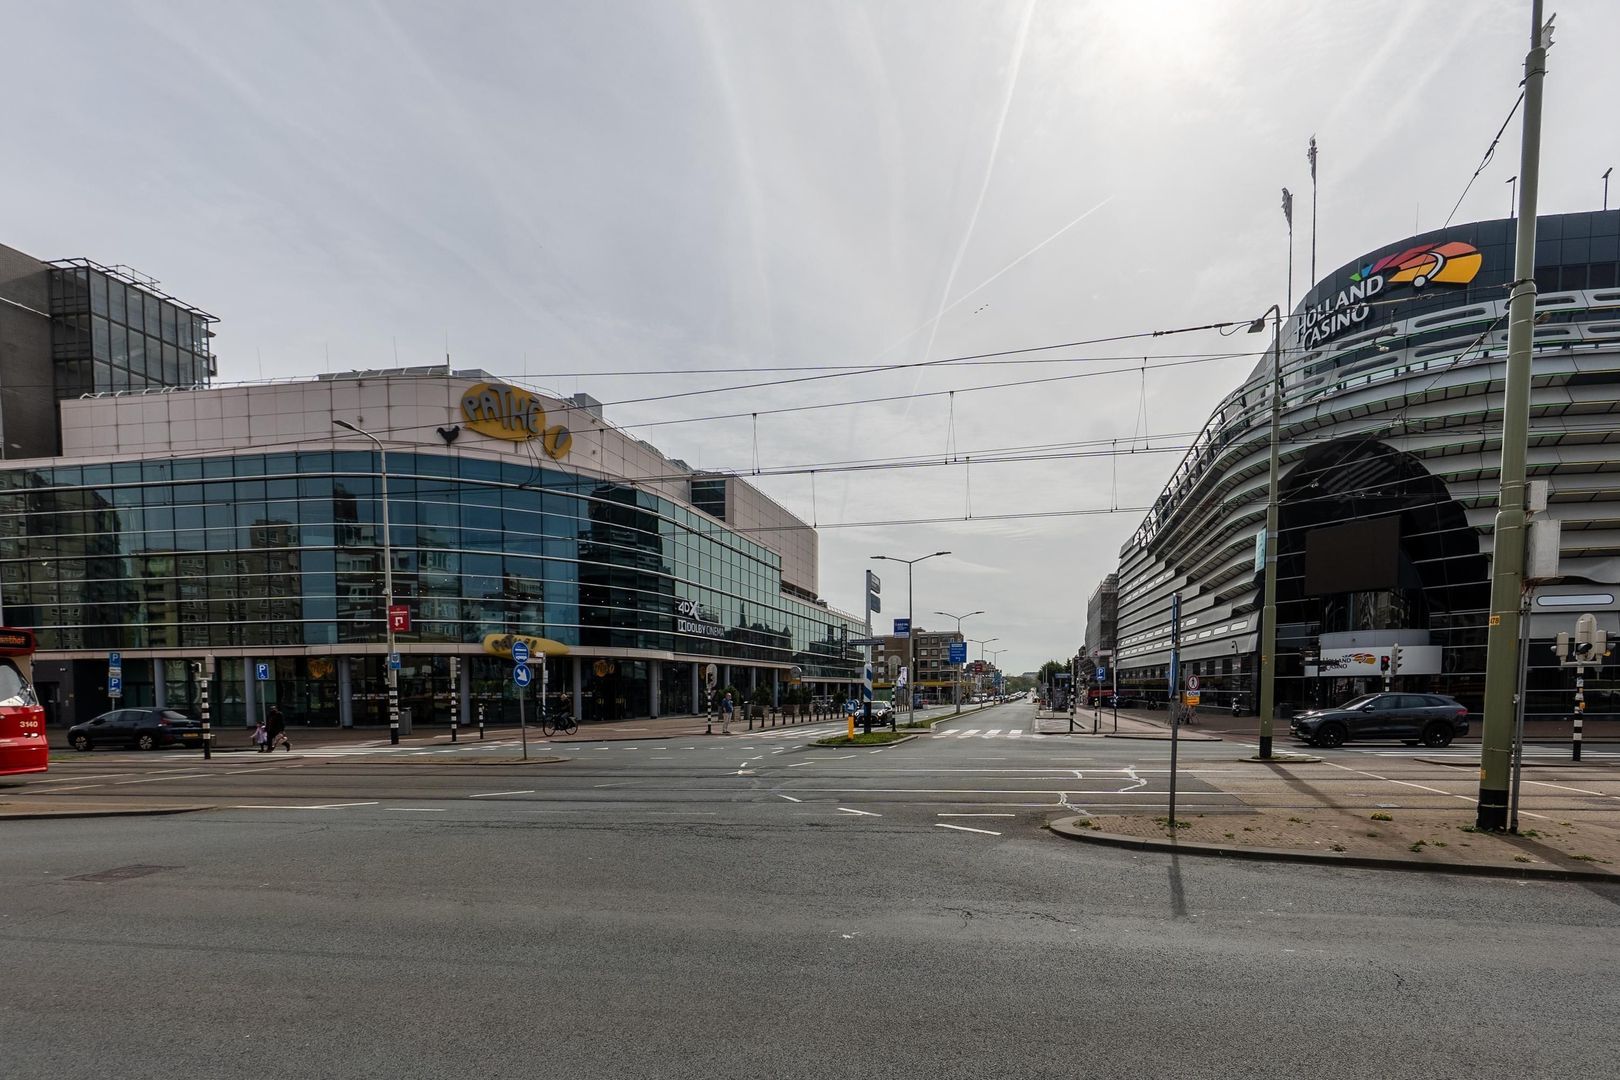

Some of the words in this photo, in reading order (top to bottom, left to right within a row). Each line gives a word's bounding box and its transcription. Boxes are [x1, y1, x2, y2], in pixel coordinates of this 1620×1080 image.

[1297, 275, 1384, 343] HOLLAND
[1303, 305, 1370, 351] CASINO
[678, 600, 701, 621] 4DX
[687, 622, 706, 635] DOLBY
[706, 625, 725, 637] CINEMA
[19, 720, 39, 728] 3140
